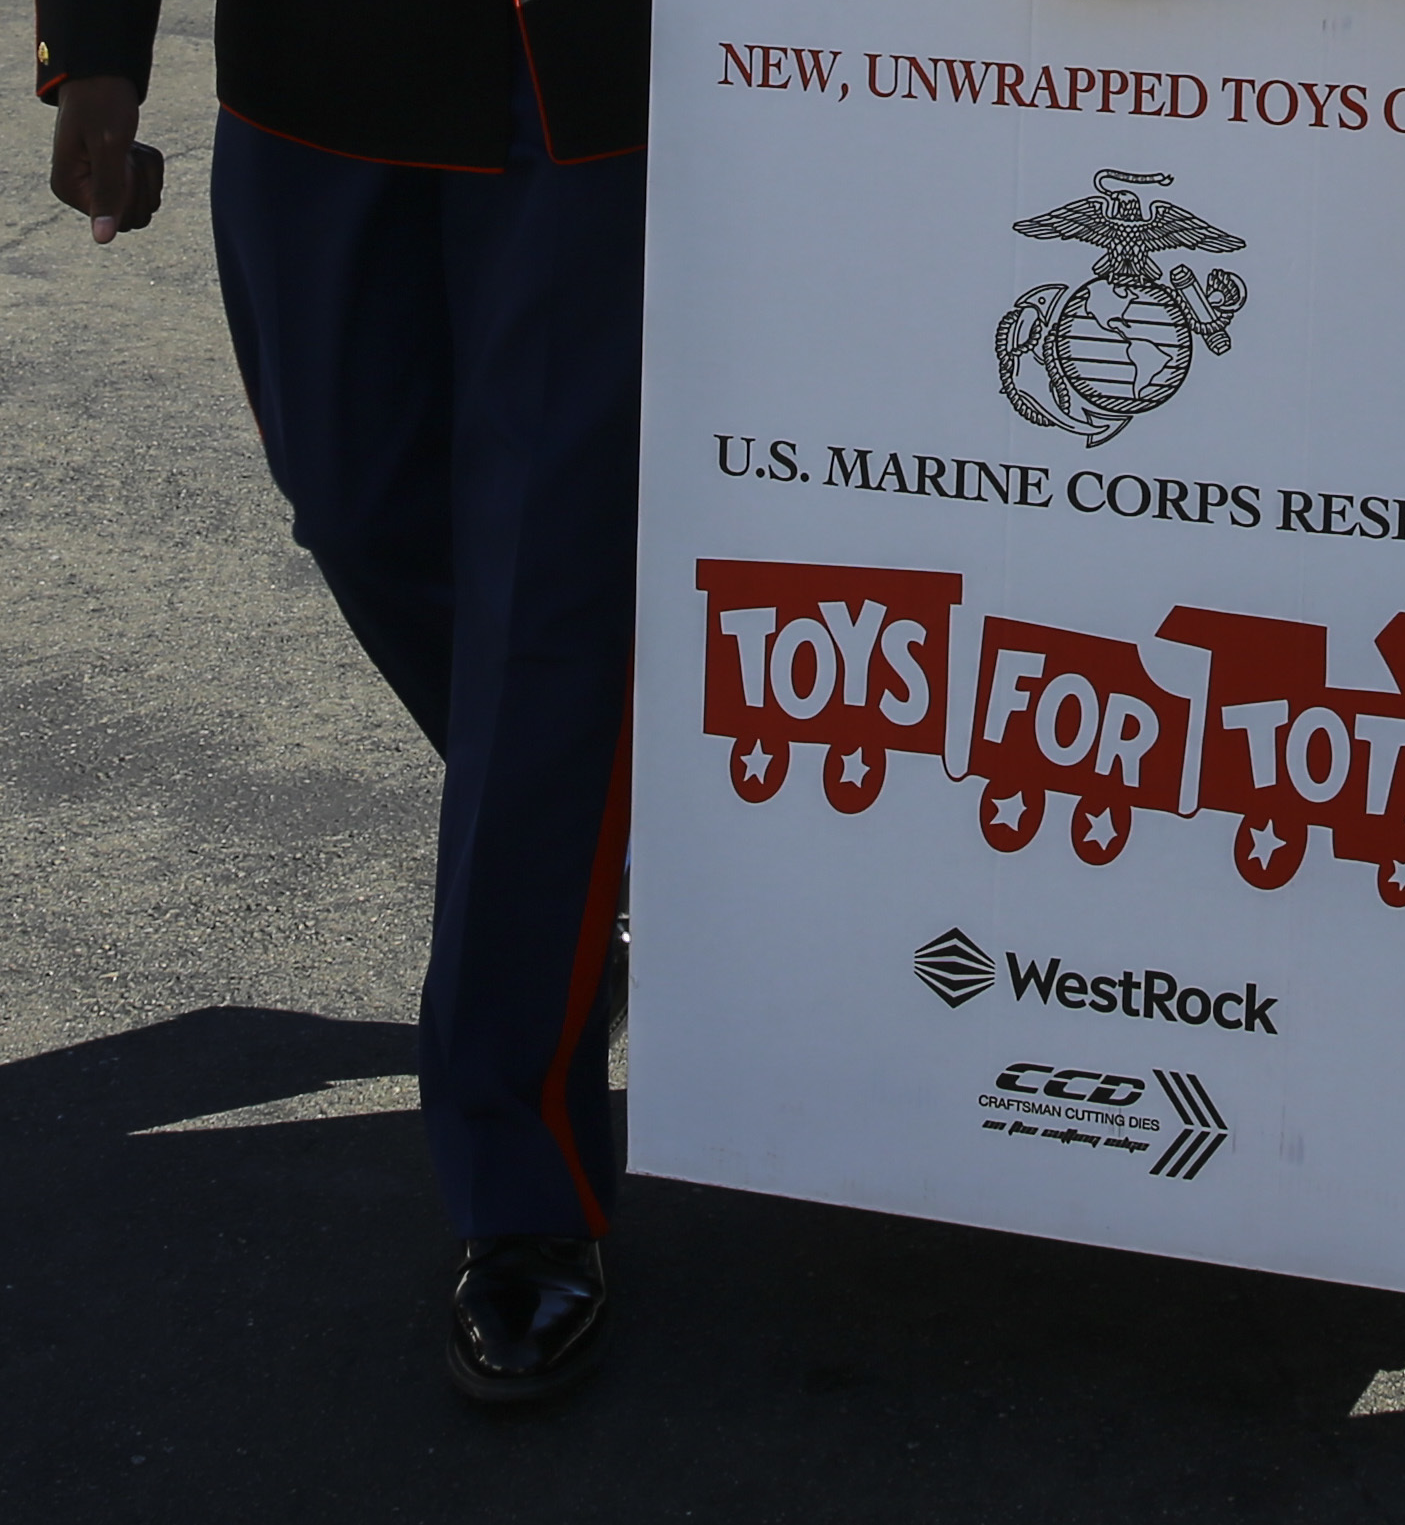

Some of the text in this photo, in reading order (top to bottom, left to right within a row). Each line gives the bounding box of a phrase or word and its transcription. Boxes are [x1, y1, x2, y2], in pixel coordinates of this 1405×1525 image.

[718, 43, 849, 103] NEW,
[863, 53, 1208, 120] UNWRAPPED
[1221, 77, 1369, 131] TOYS
[713, 434, 809, 483] U.S.
[822, 446, 1054, 509] MARINE
[1066, 471, 1261, 528] CORPS
[720, 599, 930, 727] TOYS
[983, 648, 1160, 788] FOR
[1005, 951, 1279, 1035] WestRock
[978, 1094, 1161, 1132] CRAFTSMAN CUTTING DIES
[995, 1062, 1146, 1107] CCD
[1007, 1120, 1039, 1136] the
[1041, 1127, 1102, 1149] cutting
[1103, 1136, 1150, 1154] edge
